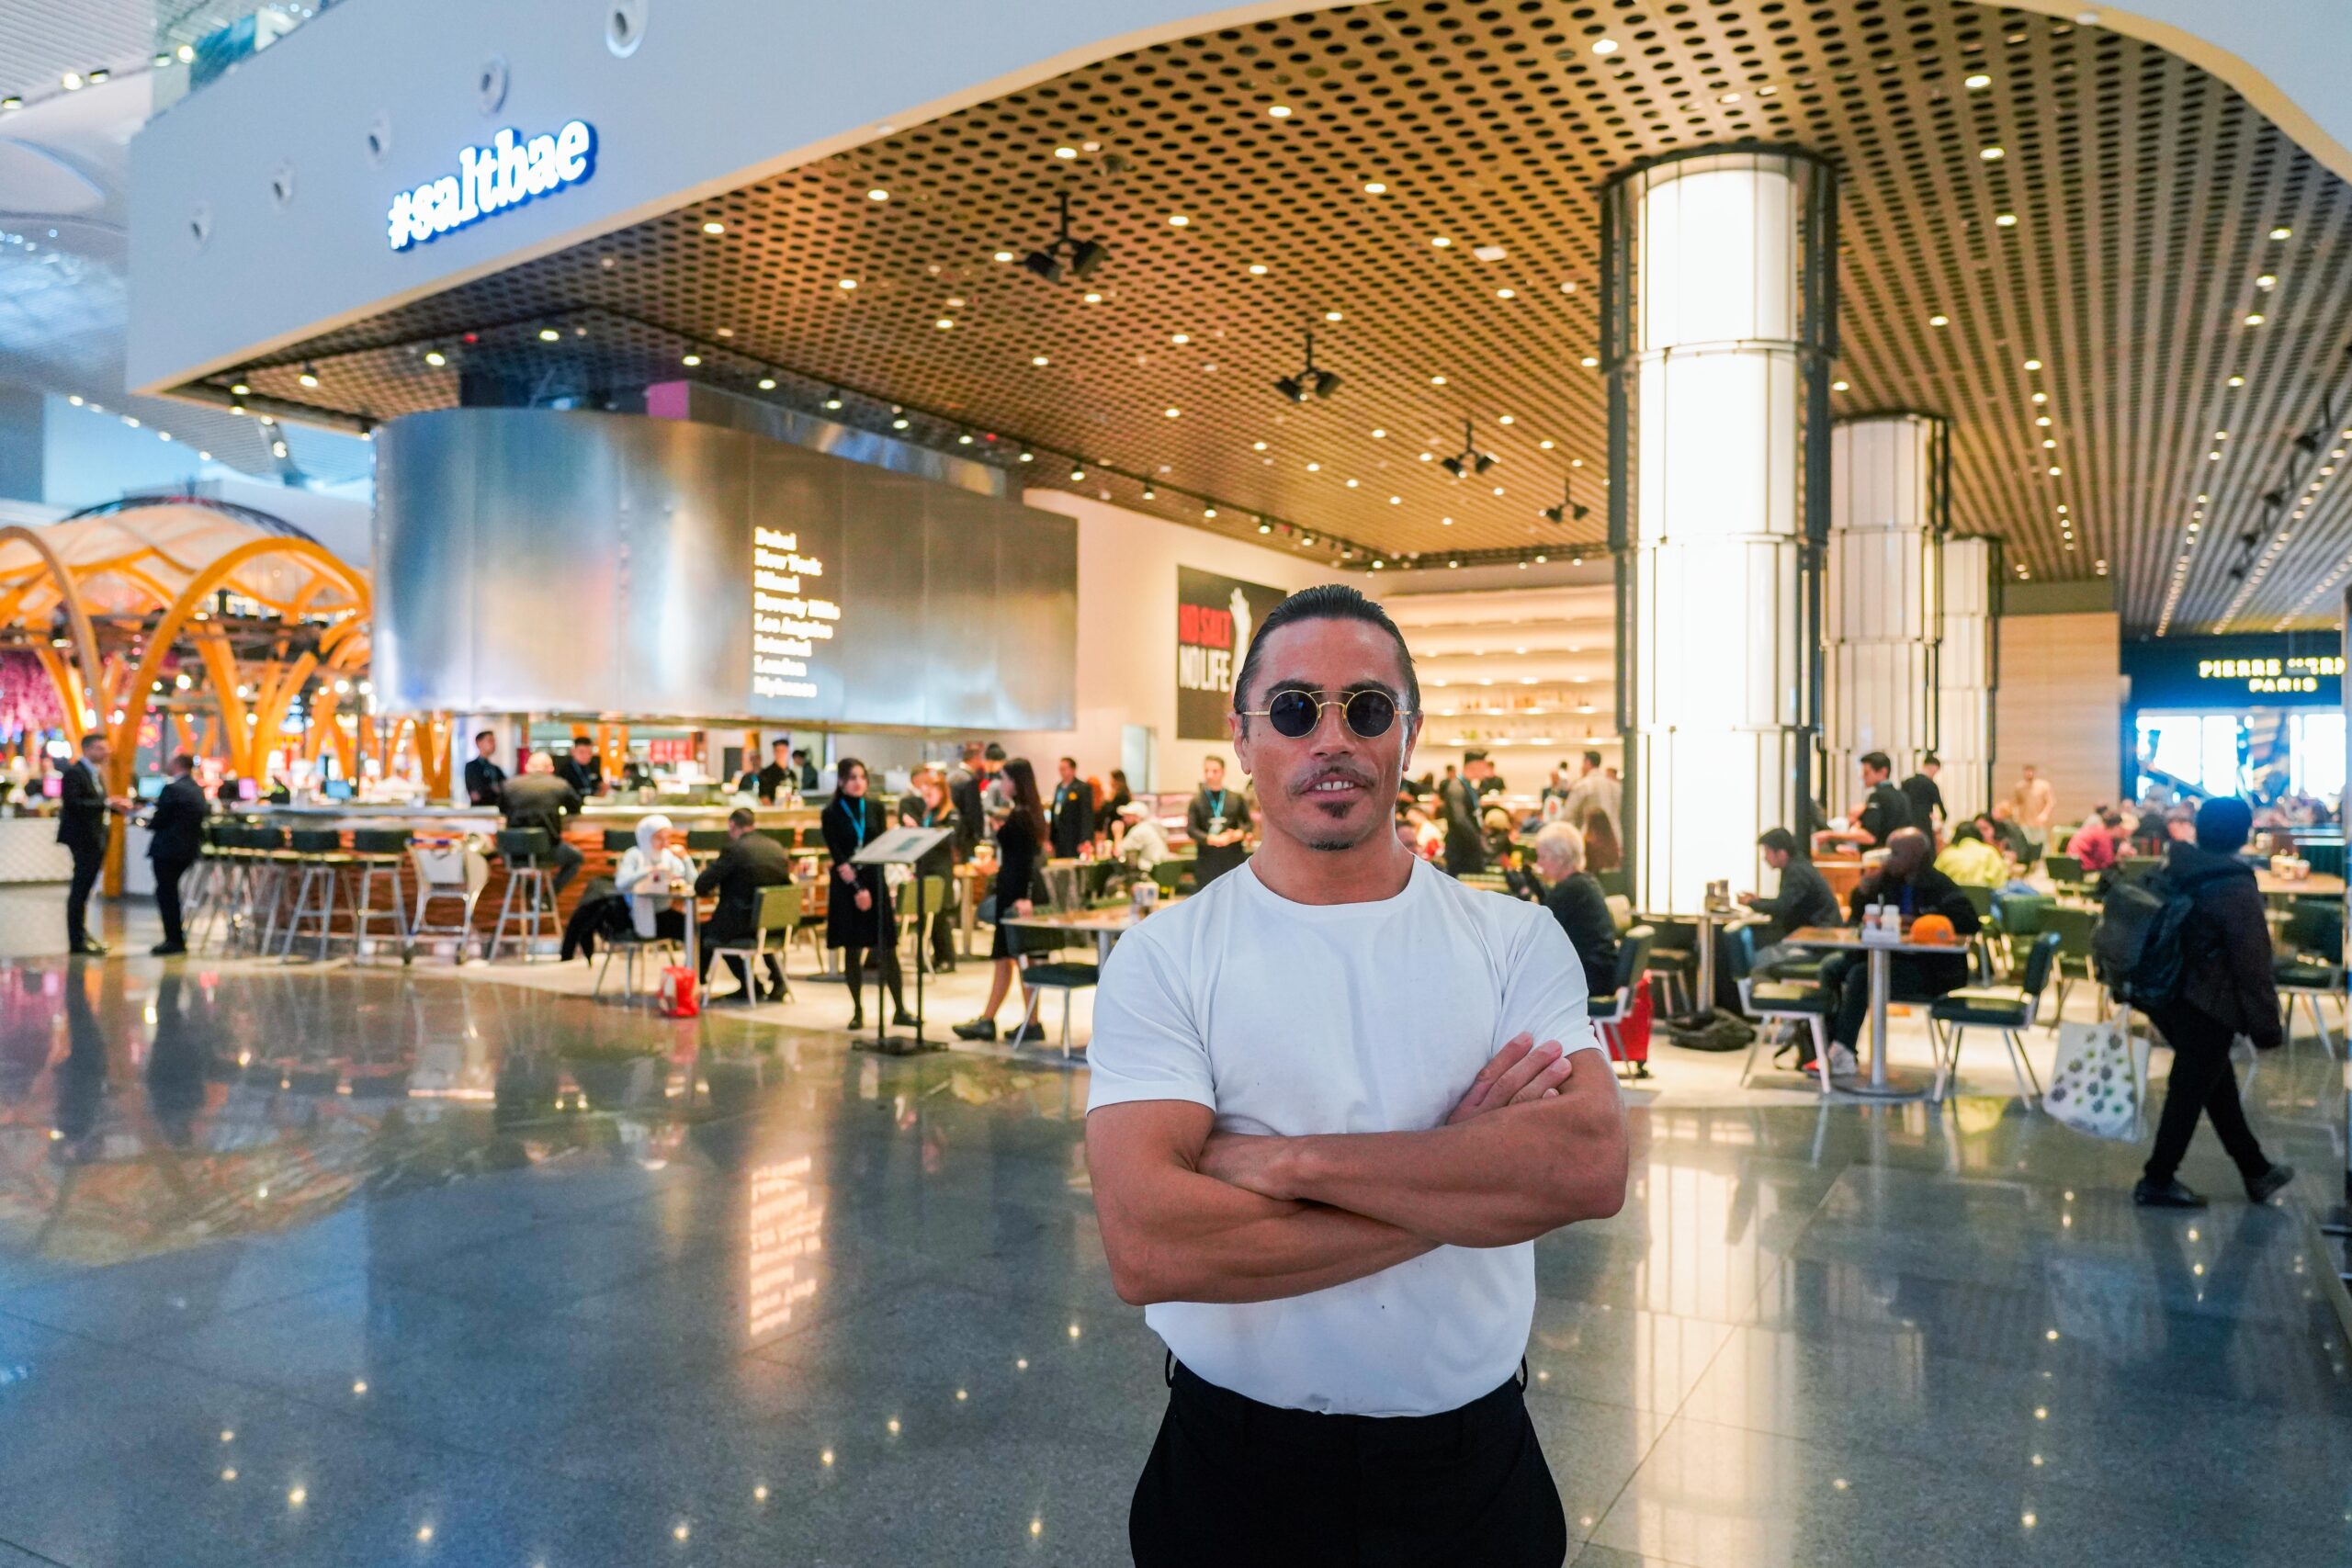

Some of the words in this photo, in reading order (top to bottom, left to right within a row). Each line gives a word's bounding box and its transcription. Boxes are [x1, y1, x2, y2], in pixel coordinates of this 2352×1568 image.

[388, 120, 595, 251] #saltbae
[754, 655, 808, 677] London
[1180, 645, 1199, 690] NO
[1200, 649, 1232, 693] LIFE
[2199, 658, 2282, 679] PIERRE
[2248, 676, 2318, 694] PARIS
